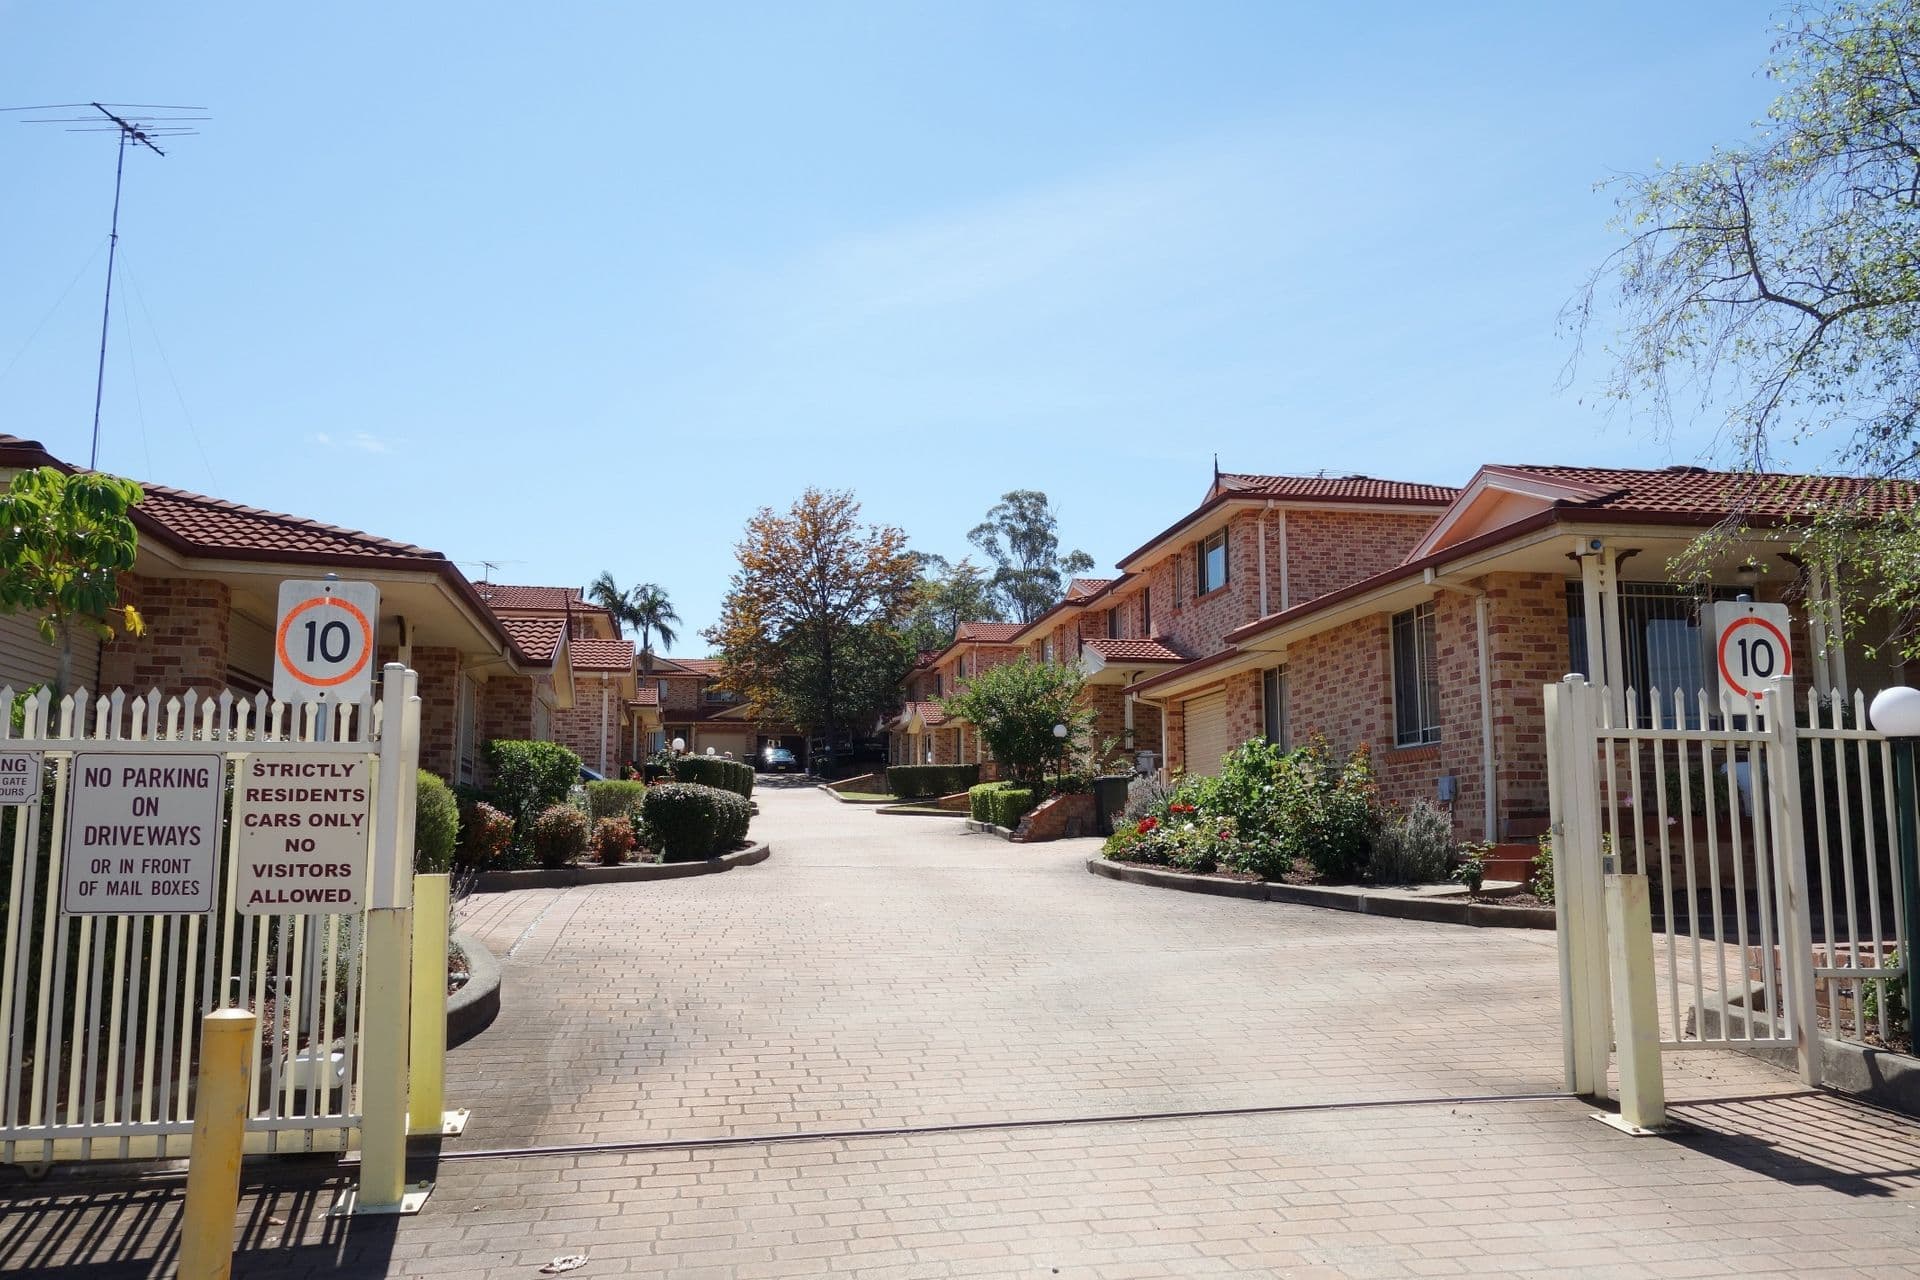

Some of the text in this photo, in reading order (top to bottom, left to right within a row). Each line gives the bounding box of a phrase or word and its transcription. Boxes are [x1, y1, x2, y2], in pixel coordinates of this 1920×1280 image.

[305, 620, 351, 663] 10
[1737, 638, 1774, 678] 10
[84, 767, 209, 788] NO PARKING
[252, 763, 355, 777] STRICTLY
[2, 777, 28, 786] GATE
[246, 788, 365, 802] RESIDENTS
[132, 796, 159, 817] ON
[244, 813, 364, 827] CARS ONLY
[83, 825, 201, 846] DRIVEWAYS
[285, 838, 316, 852] NO
[90, 858, 191, 874] OR IN FRONT
[252, 863, 352, 878] VISITORS
[78, 880, 200, 896] OF MAIL BOXES
[249, 888, 352, 904] ALLOWED
